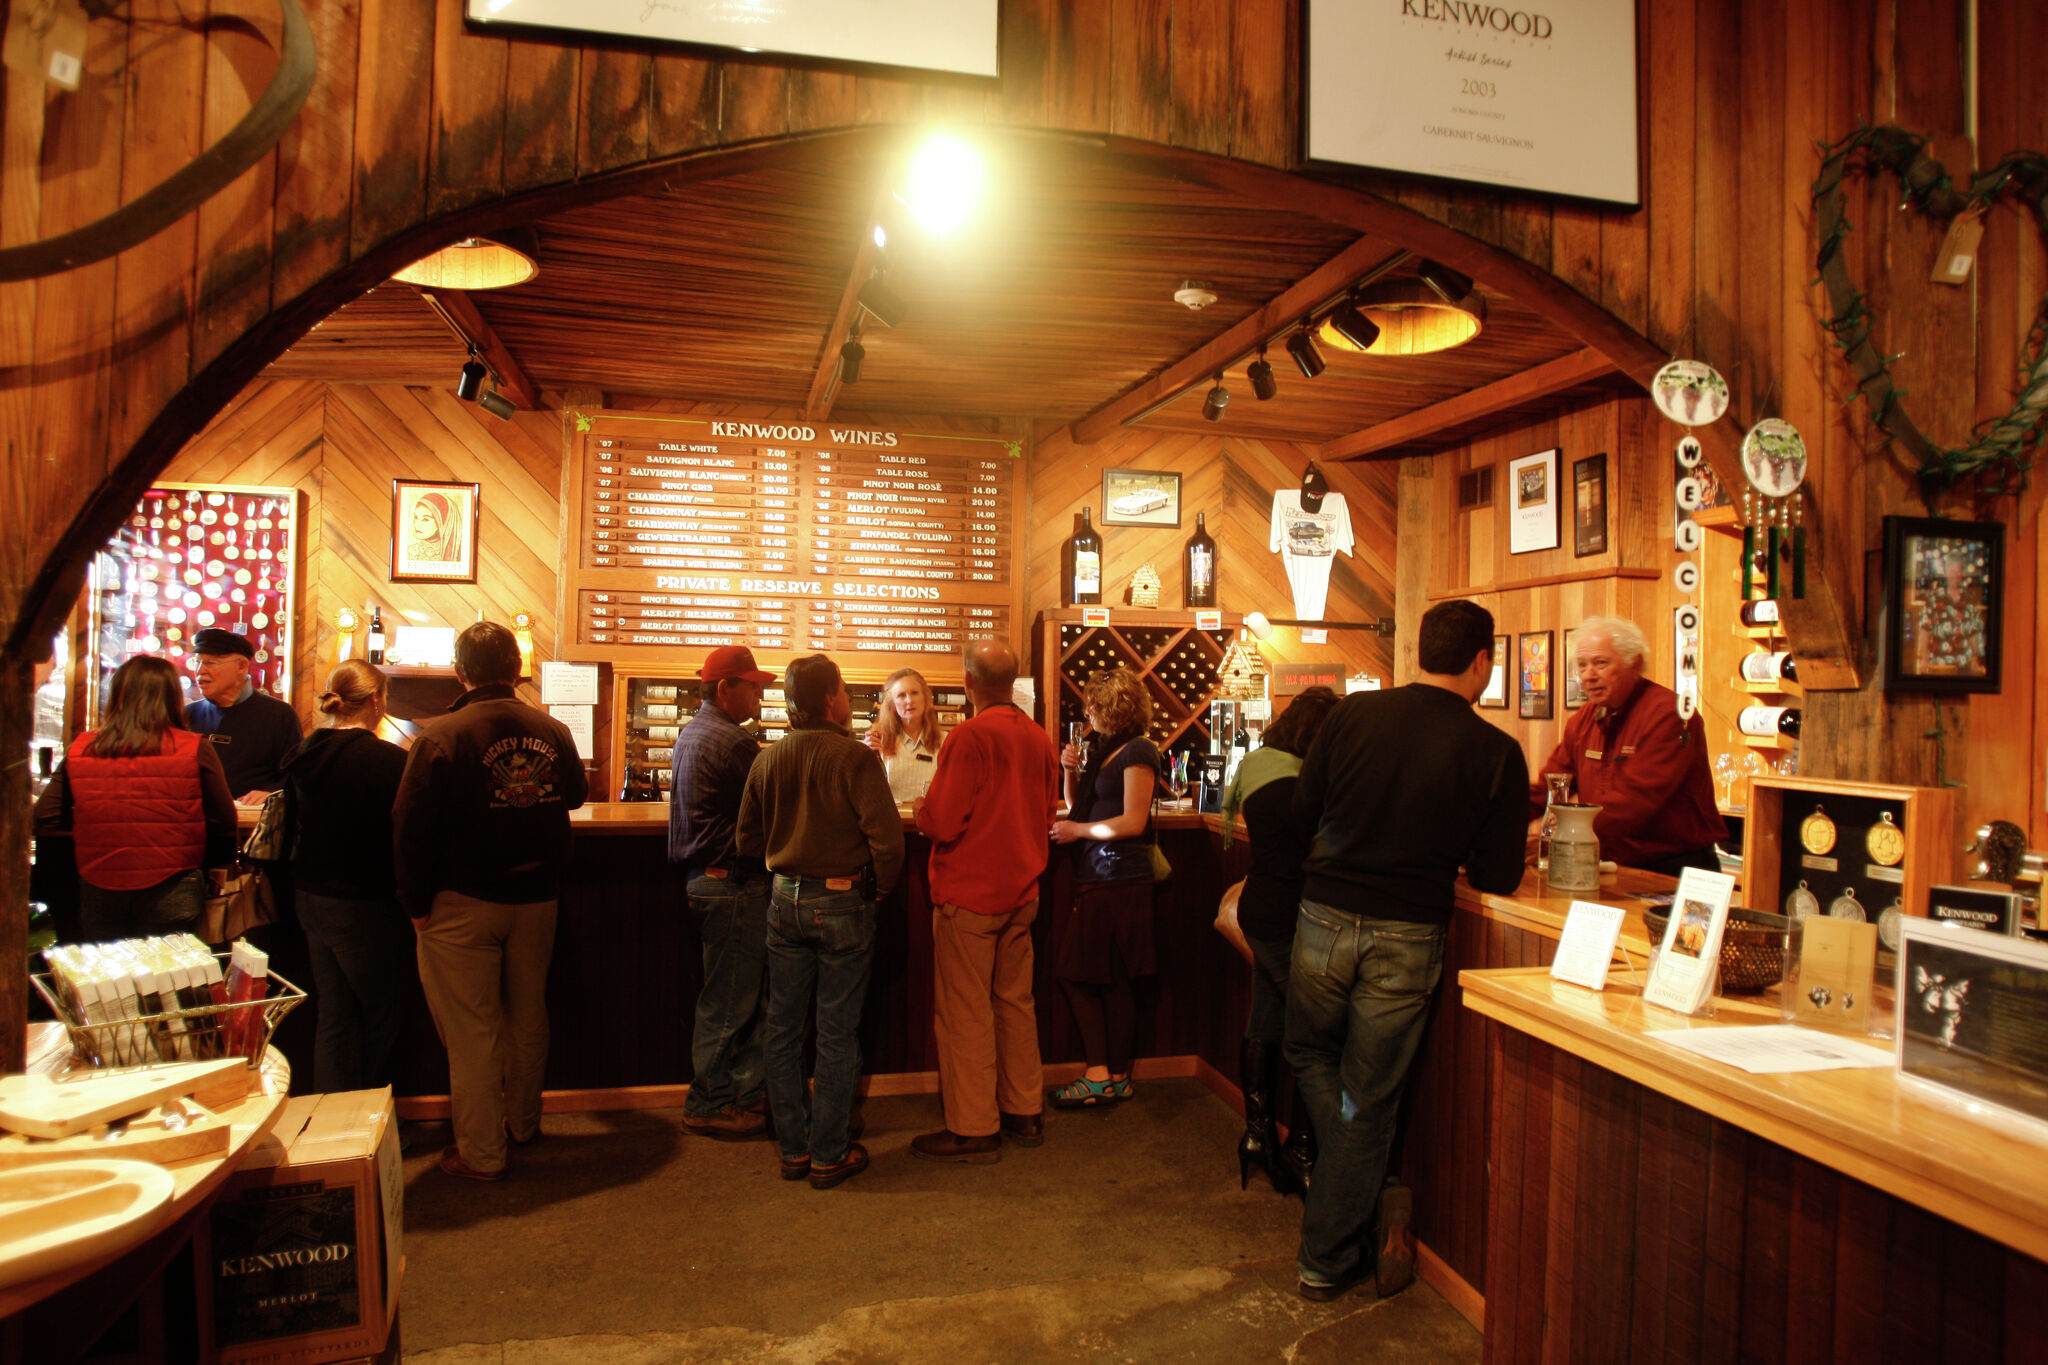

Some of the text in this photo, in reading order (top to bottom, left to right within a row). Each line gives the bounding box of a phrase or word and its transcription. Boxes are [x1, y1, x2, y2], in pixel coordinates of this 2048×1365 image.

[1401, 0, 1553, 39] KENWOOD
[1461, 78, 1497, 98] 2003
[1423, 125, 1534, 149] CABERNET SAUVIGNON
[712, 422, 898, 446] KENWOOD WINES
[658, 443, 688, 452] TABLE
[690, 445, 718, 453] WHITE
[646, 456, 700, 466] SAUVIGNON
[704, 458, 735, 467] BLANC
[880, 455, 906, 464] TABLE
[908, 456, 926, 464] RED
[630, 468, 686, 478] SAUVIGNON
[689, 471, 720, 480] BLANC
[876, 468, 903, 477] TABLE
[661, 482, 689, 490] PINOT
[691, 483, 714, 492] GRIS
[863, 480, 890, 488] PINOT
[893, 481, 915, 490] NOIR
[972, 487, 997, 495] 14.00
[628, 492, 694, 503] CHARDONNAY
[847, 492, 873, 501] PINOT
[875, 493, 898, 502] NOIR
[628, 506, 698, 517] CHARDONNAY
[848, 505, 889, 514] MERLOT
[627, 520, 700, 530] CHARDONNAY
[846, 517, 886, 526] MERLOT
[637, 533, 731, 544] GEWURZTRAMINER
[860, 530, 996, 545] ZINFANDEL (YULUPA) 12.00
[629, 546, 656, 554] WHITE
[850, 543, 902, 552] ZINFANDEL
[844, 556, 885, 564] CABERNET
[889, 558, 932, 566] SAUVIGNON
[859, 568, 893, 576] CABERNET
[926, 570, 953, 579] COUNTY)
[1680, 445, 1699, 713] WELCOME
[656, 576, 940, 599] PRIVATE RESERVE SELECTIONS
[641, 596, 667, 604] PINOT
[670, 597, 692, 605] NOIR
[641, 609, 682, 617] MERLOT
[684, 611, 734, 620] (RESERVE)
[640, 622, 673, 630] MERLOT
[852, 617, 879, 625] SYRAH
[881, 618, 915, 626] (LONDON
[917, 619, 947, 627] RANCH)
[969, 621, 993, 629] 25.00
[632, 635, 683, 644] ZINFANDEL
[685, 637, 732, 645] (RESERVE)
[856, 629, 893, 638] CABERNET
[895, 631, 925, 639] (LONDON
[926, 632, 952, 640] RANCH)
[856, 642, 893, 651] CABERNET
[926, 644, 952, 652] SERIES)
[482, 737, 558, 767] MICKEY MOUSE
[1938, 906, 1999, 923] KENWOOD
[221, 1244, 349, 1277] KENWOOD
[258, 1292, 319, 1308] MERLOT
